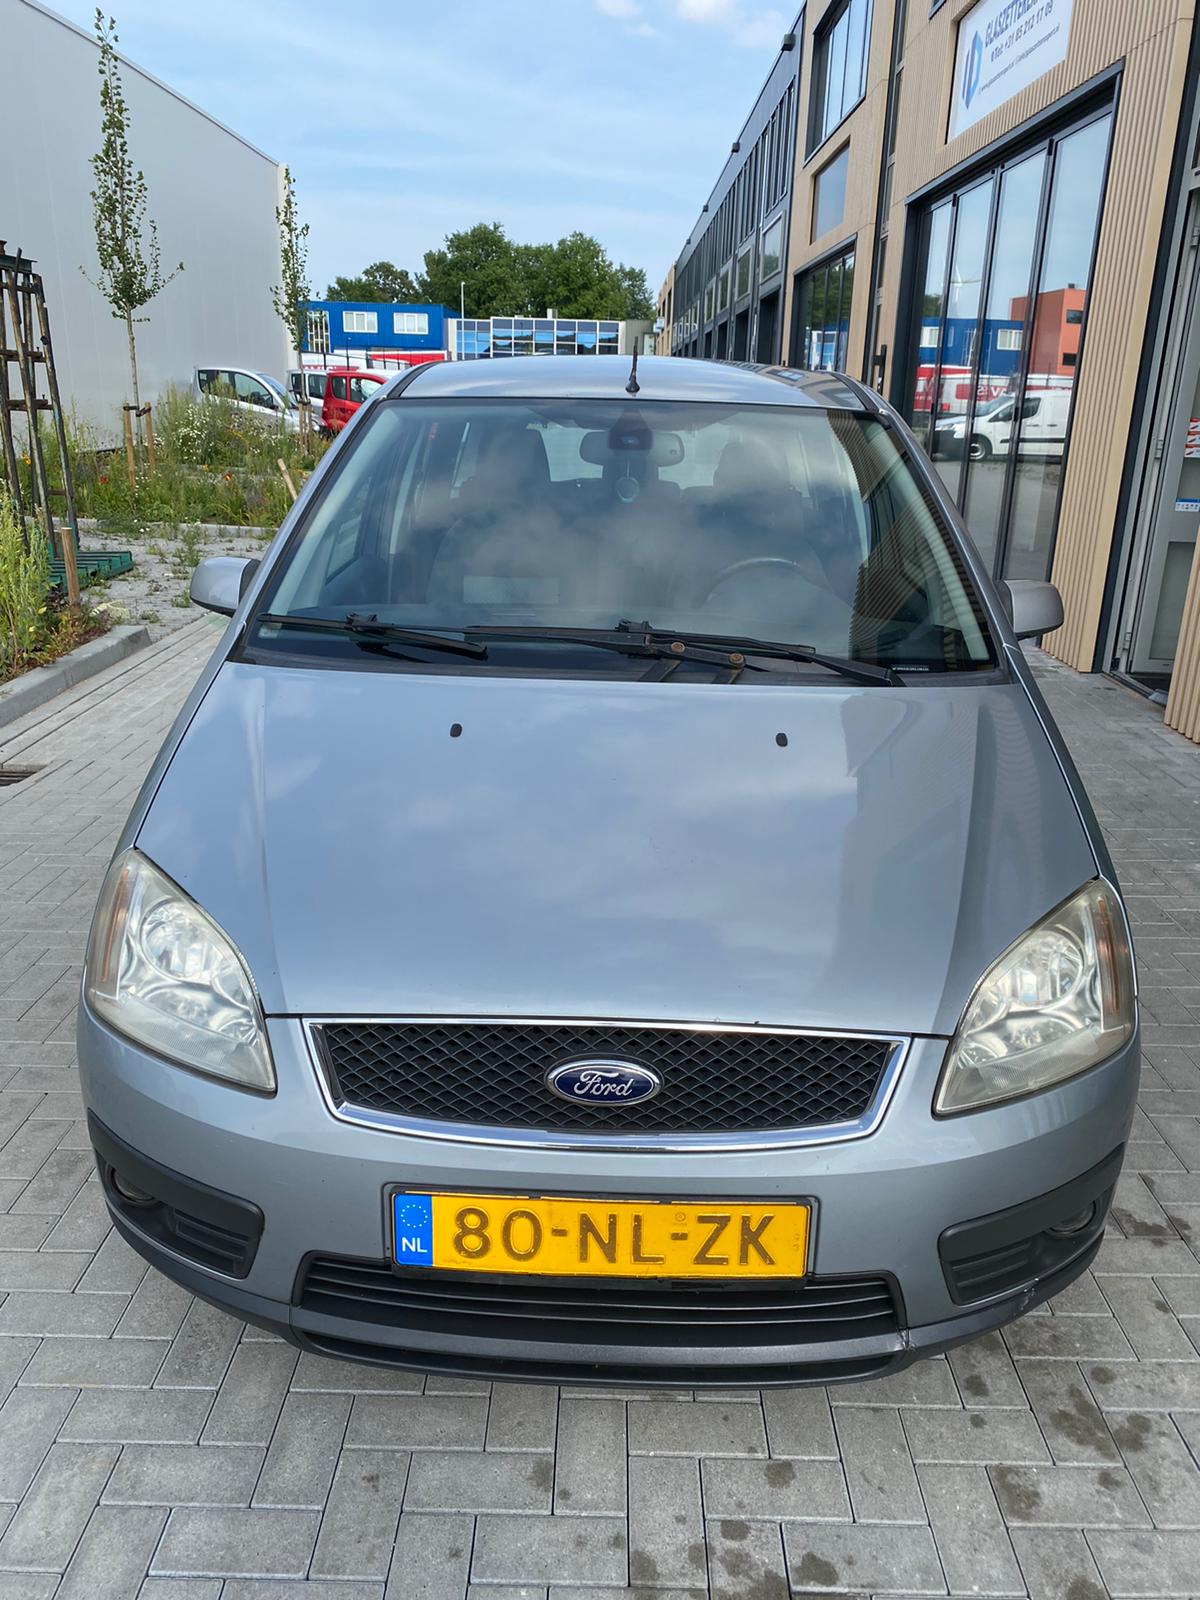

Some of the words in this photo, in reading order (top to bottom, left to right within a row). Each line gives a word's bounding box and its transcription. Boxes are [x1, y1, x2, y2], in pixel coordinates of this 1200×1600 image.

[573, 1070, 635, 1096] Ford
[401, 1237, 428, 1254] NL
[452, 1205, 777, 1266] 80-NL-ZK
